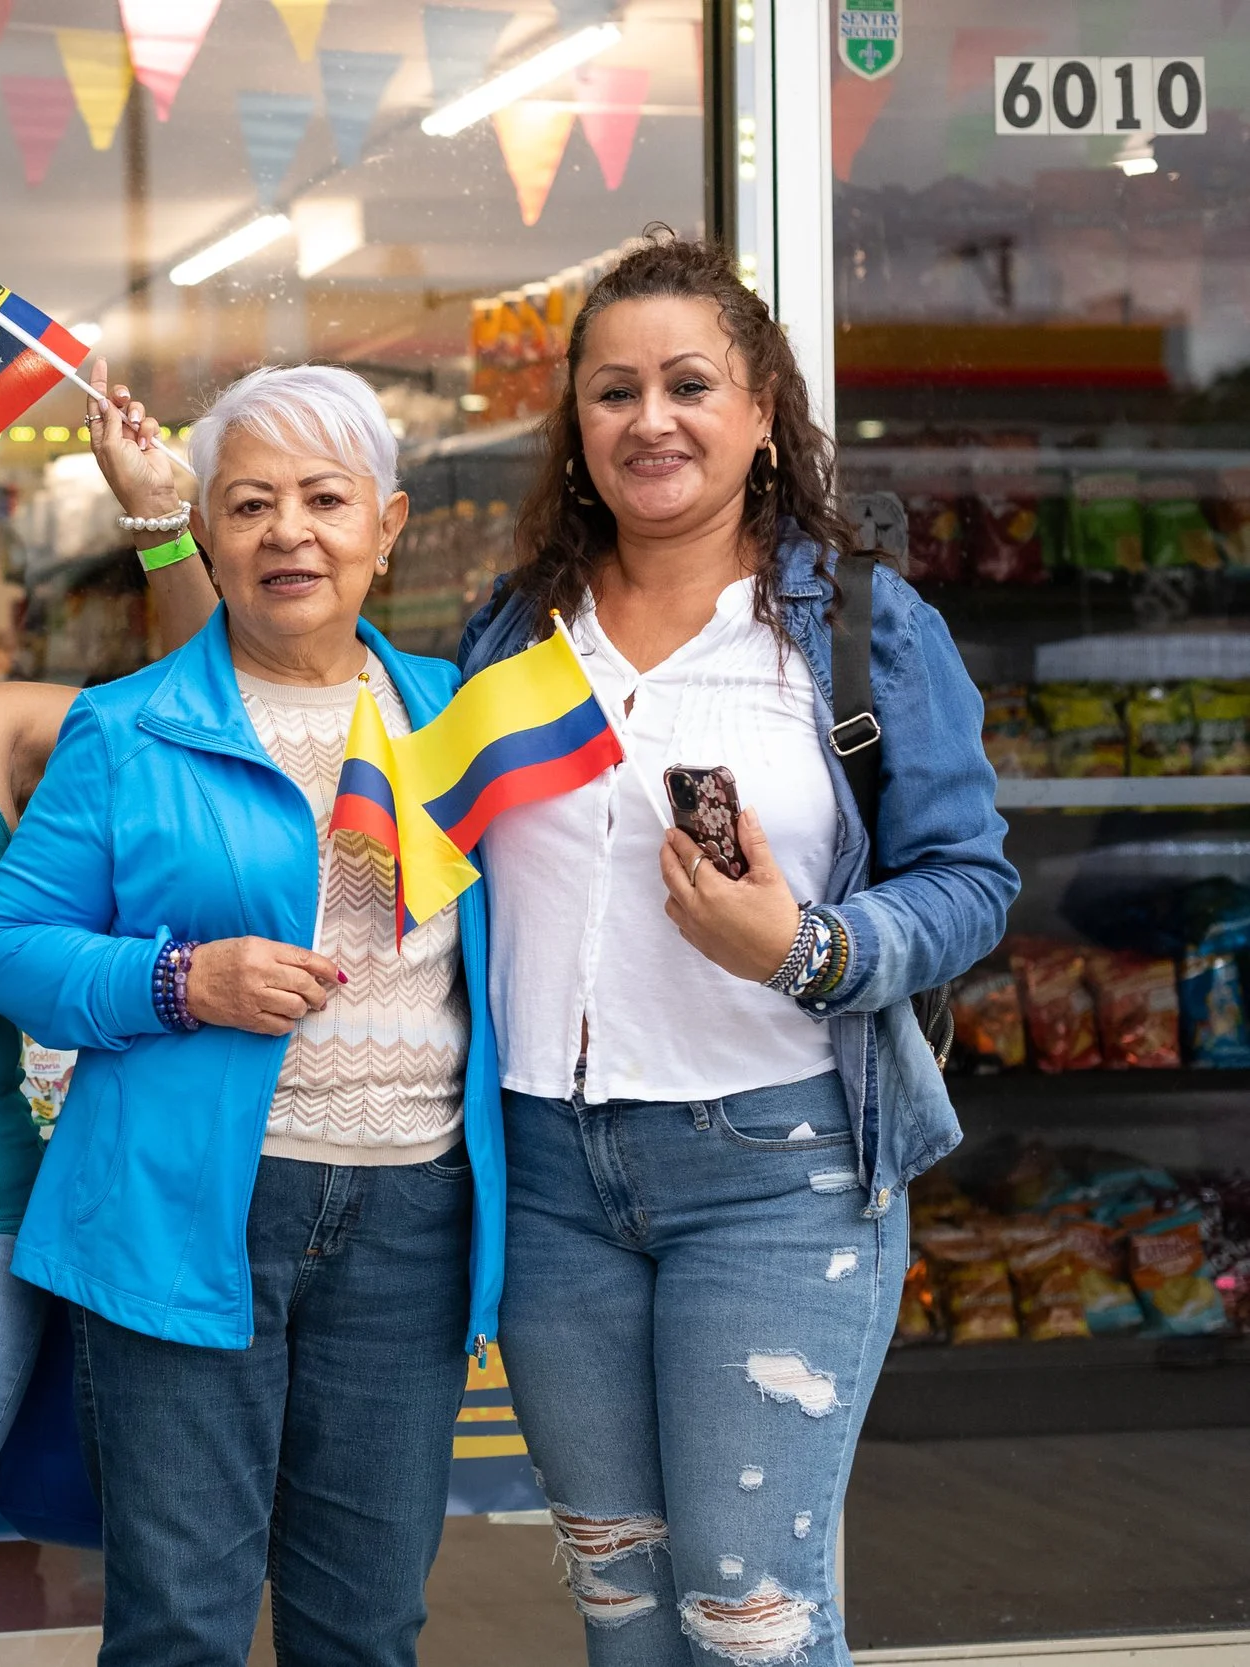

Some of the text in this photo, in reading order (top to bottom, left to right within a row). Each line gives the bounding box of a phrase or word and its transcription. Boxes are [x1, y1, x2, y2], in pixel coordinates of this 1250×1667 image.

[840, 12, 899, 26] SENTRY
[840, 27, 899, 38] SECURITY
[1001, 60, 1203, 131] 6010
